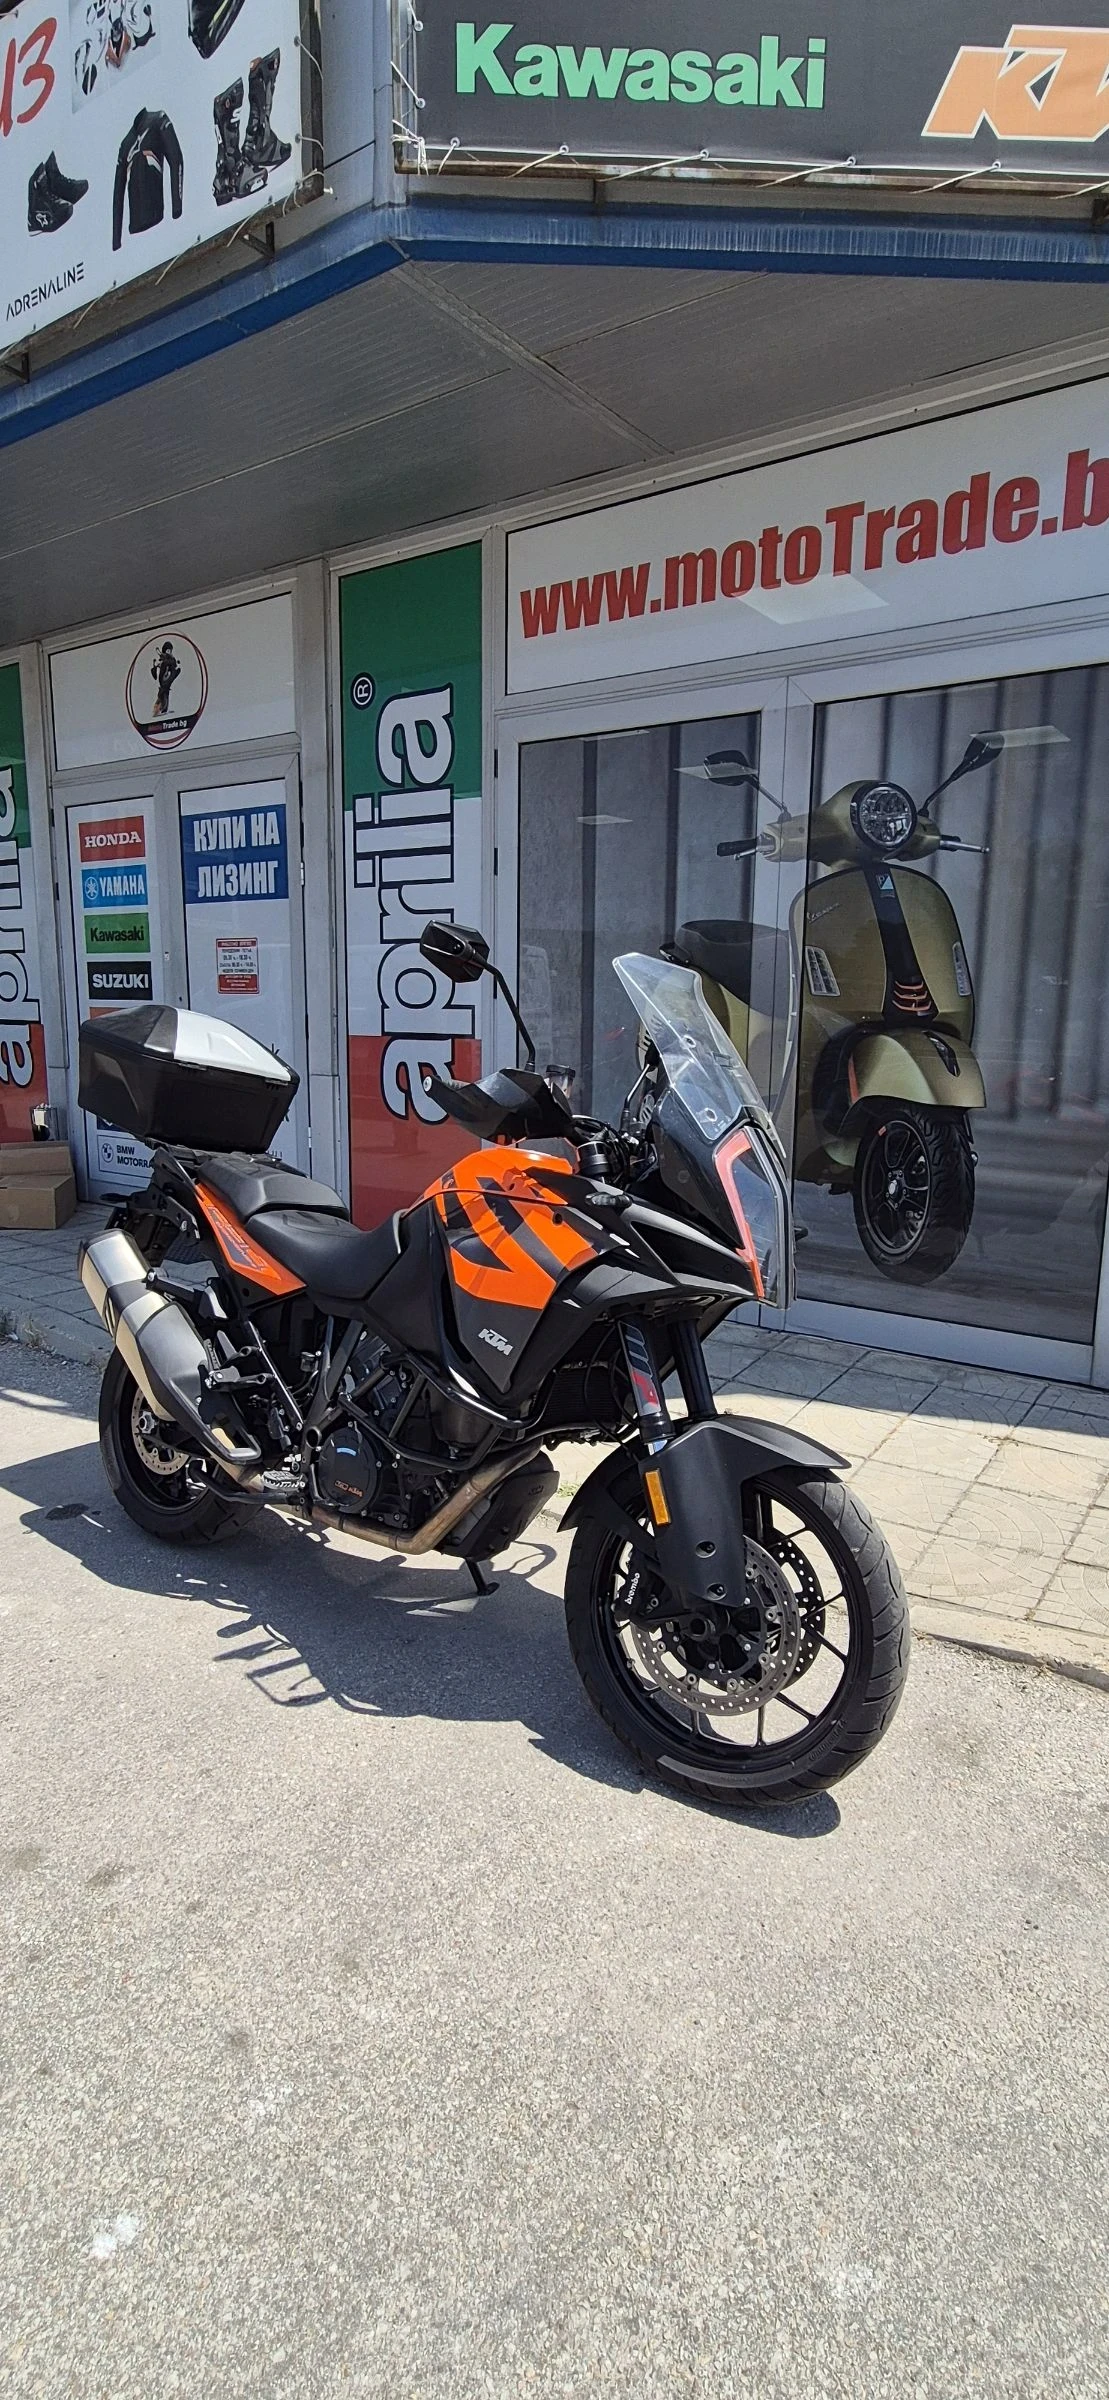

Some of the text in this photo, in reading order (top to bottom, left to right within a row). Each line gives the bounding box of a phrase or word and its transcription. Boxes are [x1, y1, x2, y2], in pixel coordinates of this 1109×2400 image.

[456, 21, 826, 109] Kawasaki
[921, 24, 1109, 142] KT
[6, 262, 84, 321] ADRENALINE
[85, 831, 142, 848] HONDA
[193, 811, 281, 852] КУПИ НА
[99, 874, 146, 897] YAMAHA
[197, 860, 279, 898] ЛИЗИНГ
[353, 682, 475, 1125] aprilia
[90, 926, 145, 942] Kawasaki
[92, 973, 149, 989] SUZUKI
[116, 1145, 135, 1155] BMW
[478, 1328, 514, 1356] KTM
[624, 1572, 640, 1605] brembo
